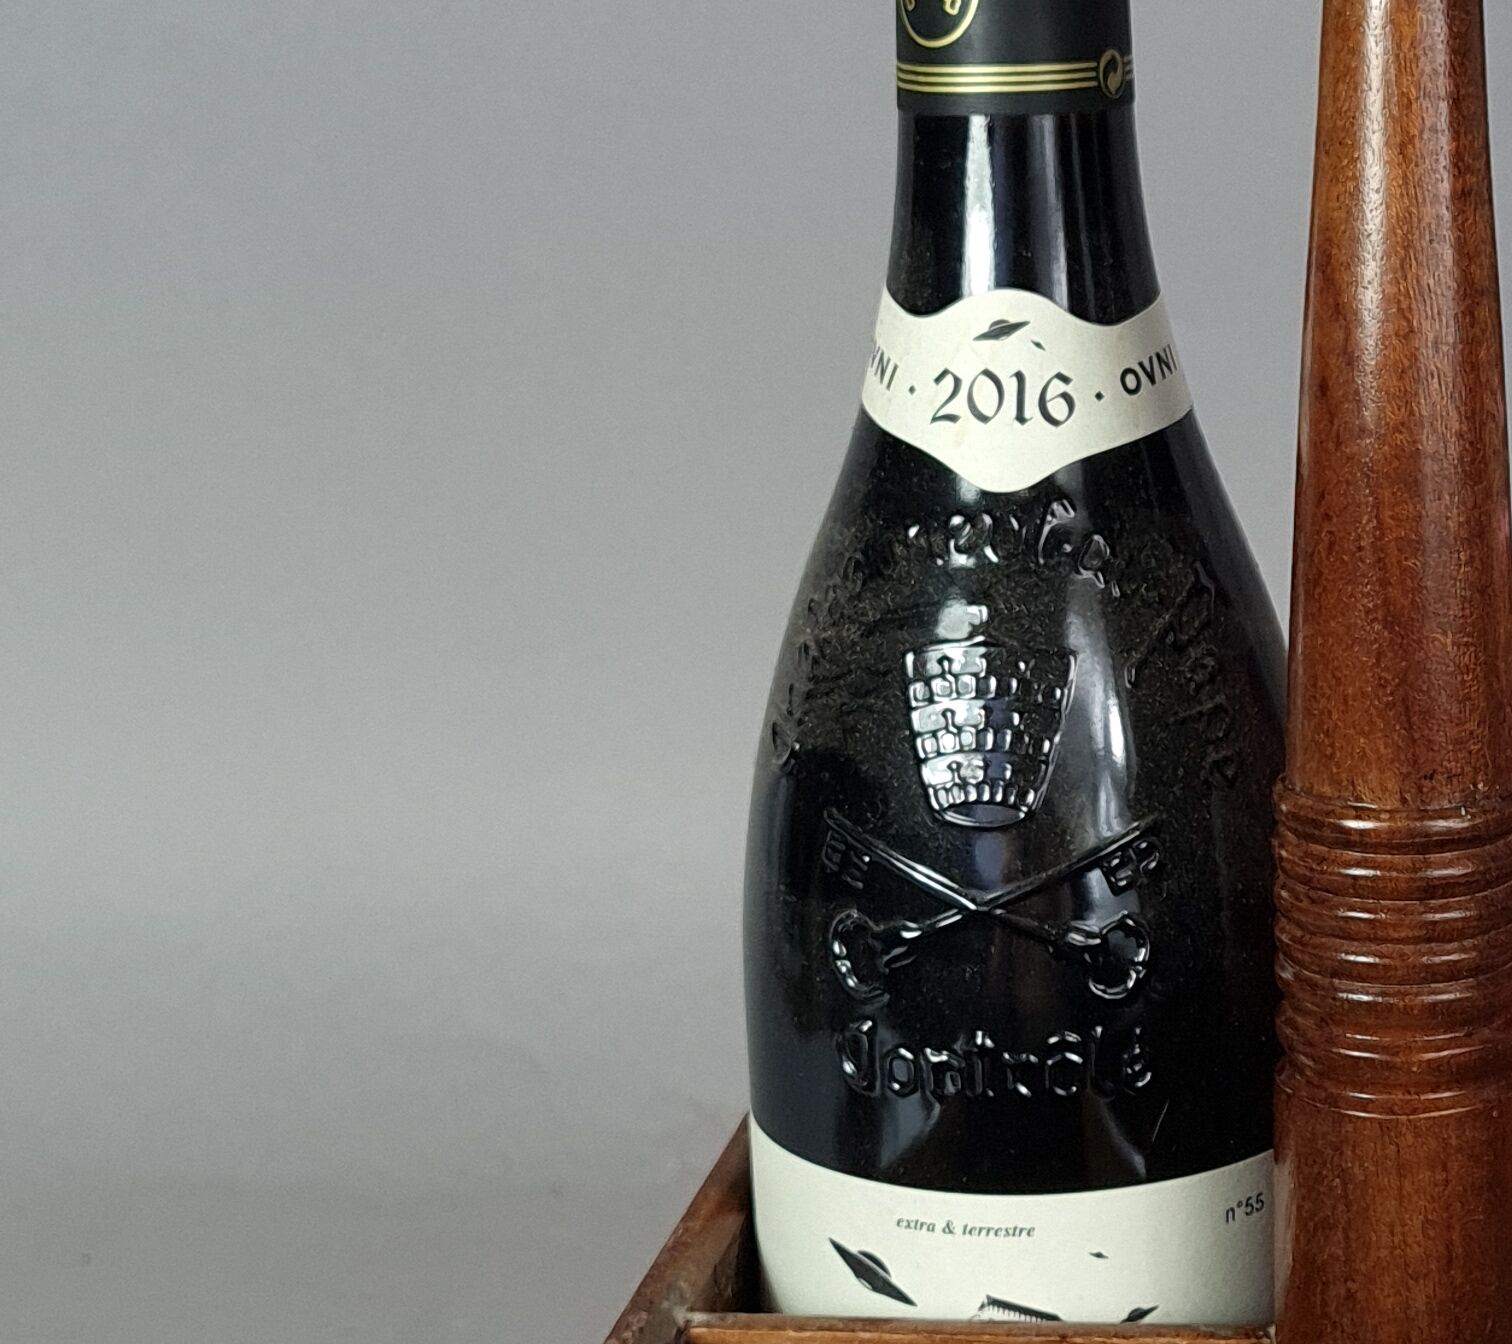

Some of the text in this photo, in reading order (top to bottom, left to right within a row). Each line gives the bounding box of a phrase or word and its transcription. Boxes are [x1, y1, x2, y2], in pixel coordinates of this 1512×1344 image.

[930, 367, 1076, 428] 2016
[1119, 344, 1178, 396] OVNI
[1224, 1191, 1266, 1224] n°55
[896, 1216, 1036, 1239] extra & terrestre
